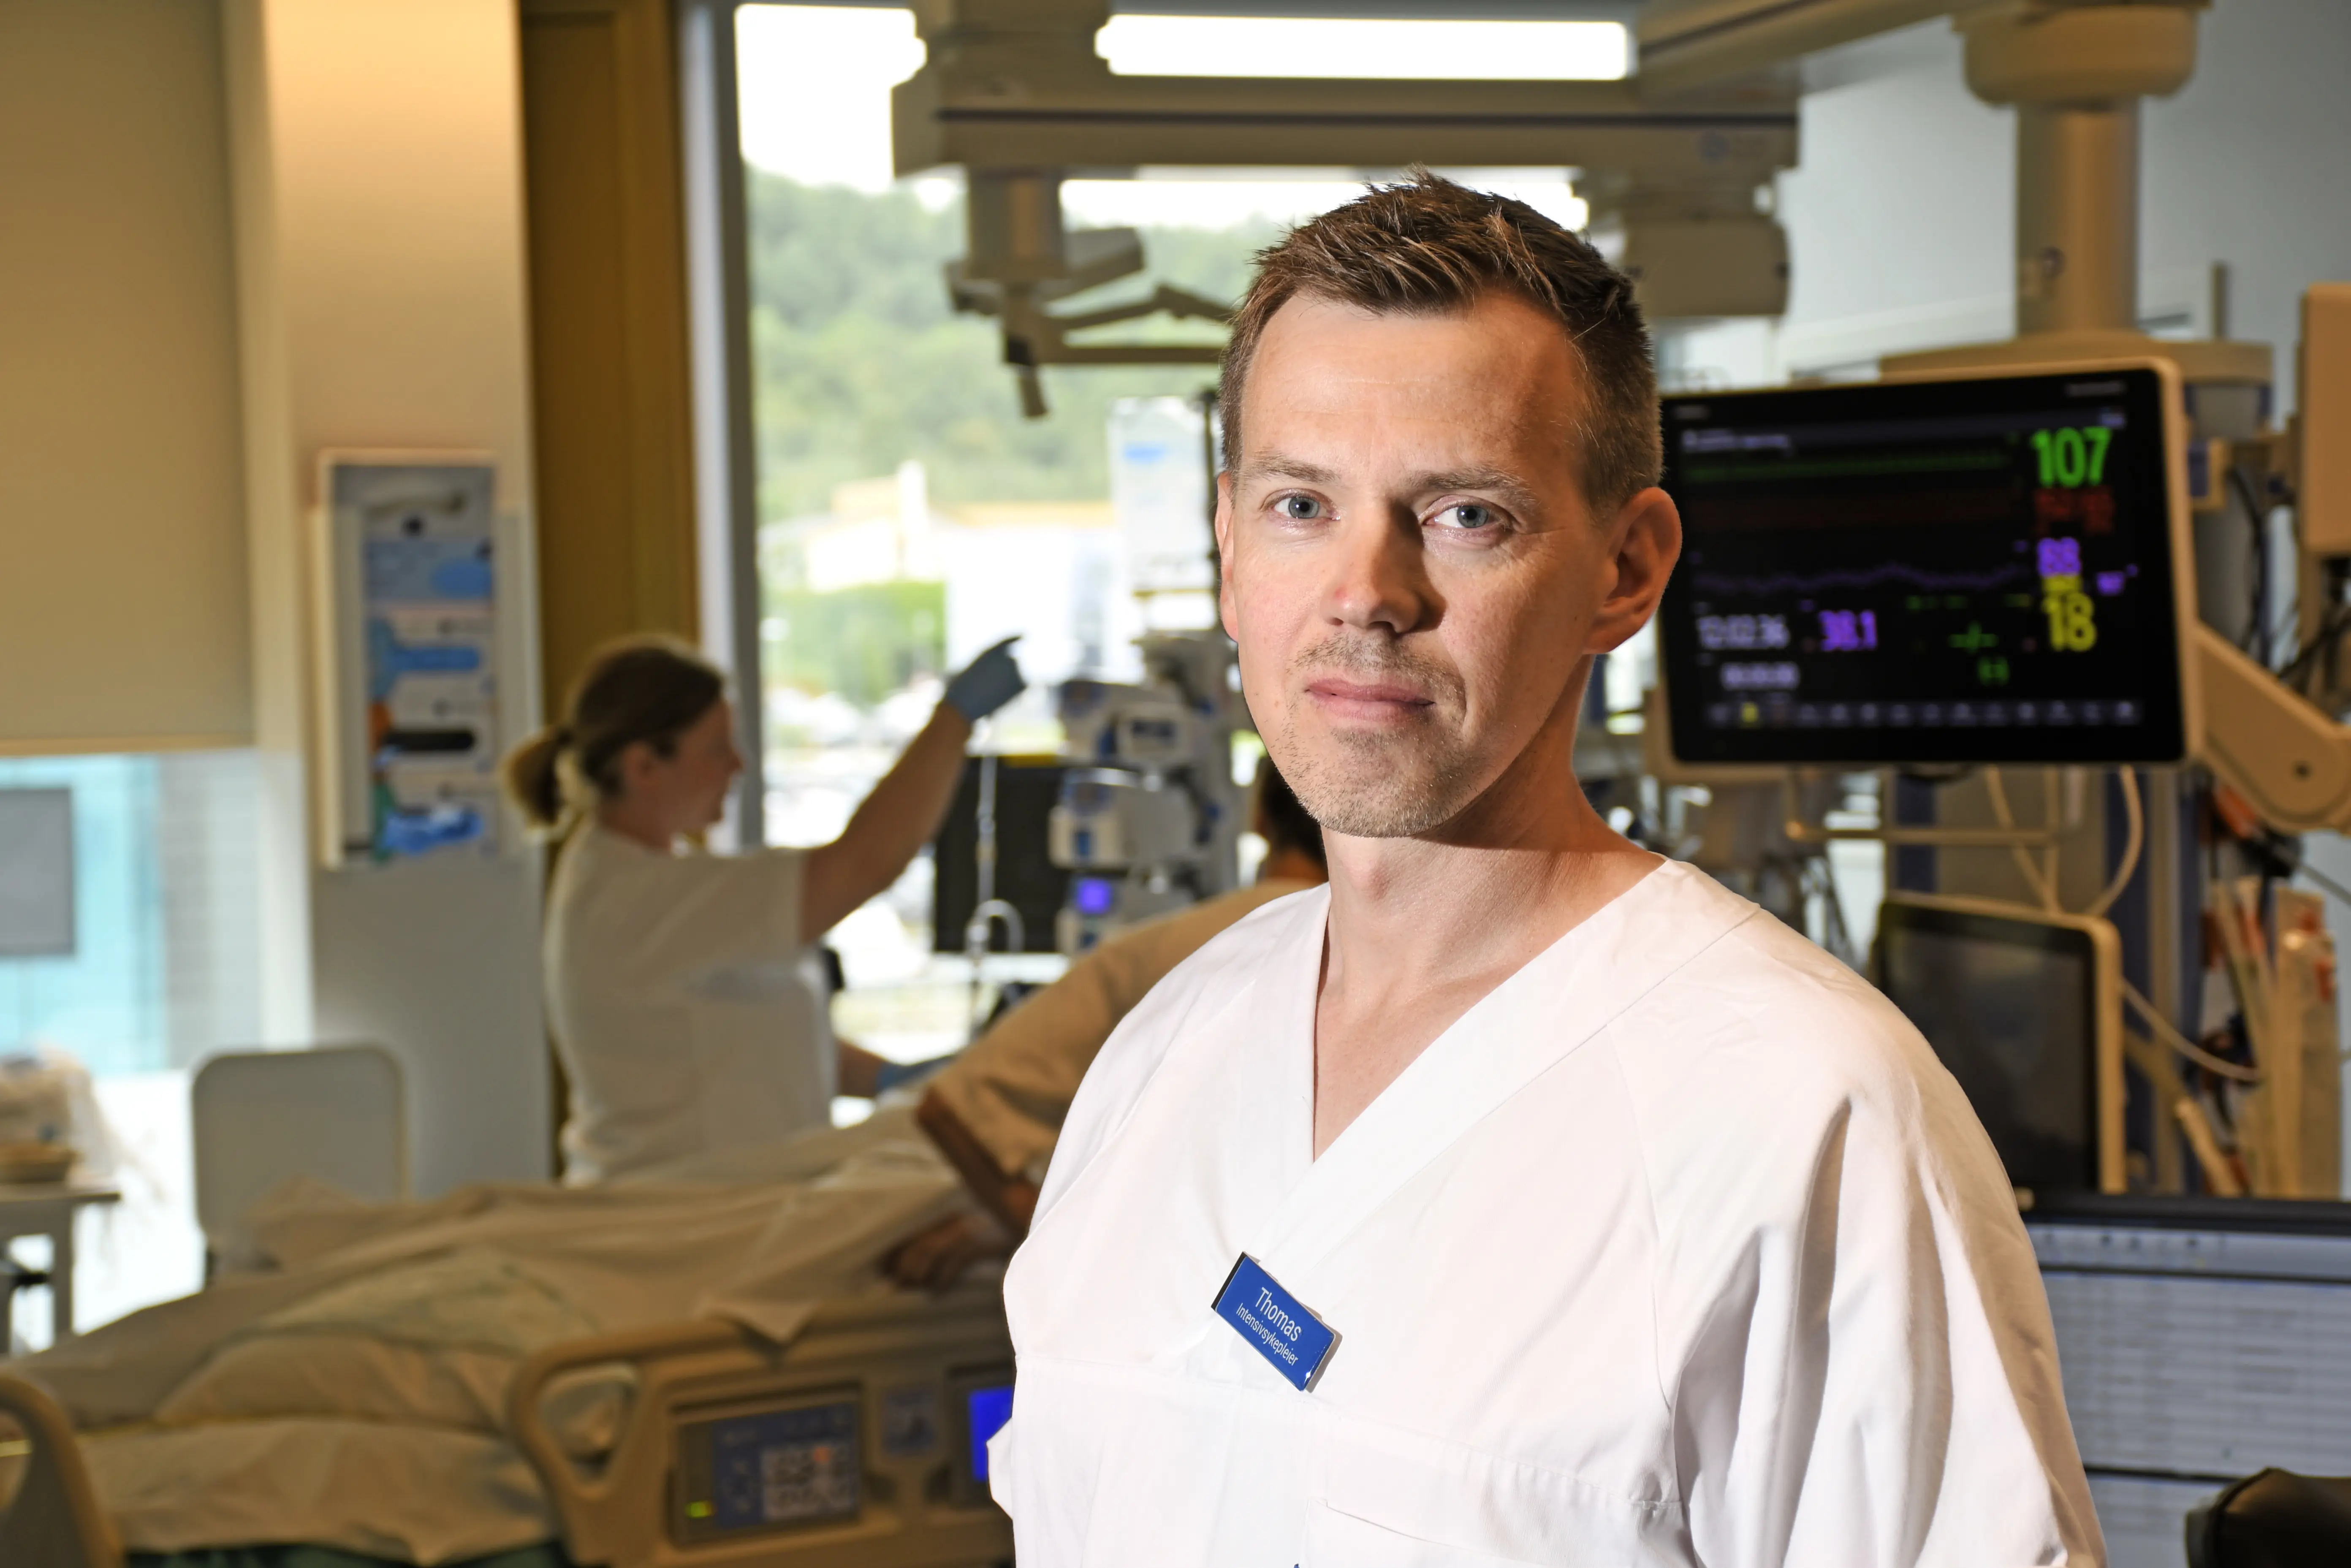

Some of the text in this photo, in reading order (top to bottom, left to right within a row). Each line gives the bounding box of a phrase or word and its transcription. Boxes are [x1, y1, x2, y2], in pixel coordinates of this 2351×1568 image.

[2031, 427, 2110, 487] 107
[2042, 592, 2097, 651] 18
[1236, 1302, 1298, 1366] Intensivsykepleier
[1254, 1287, 1302, 1342] Thomas
